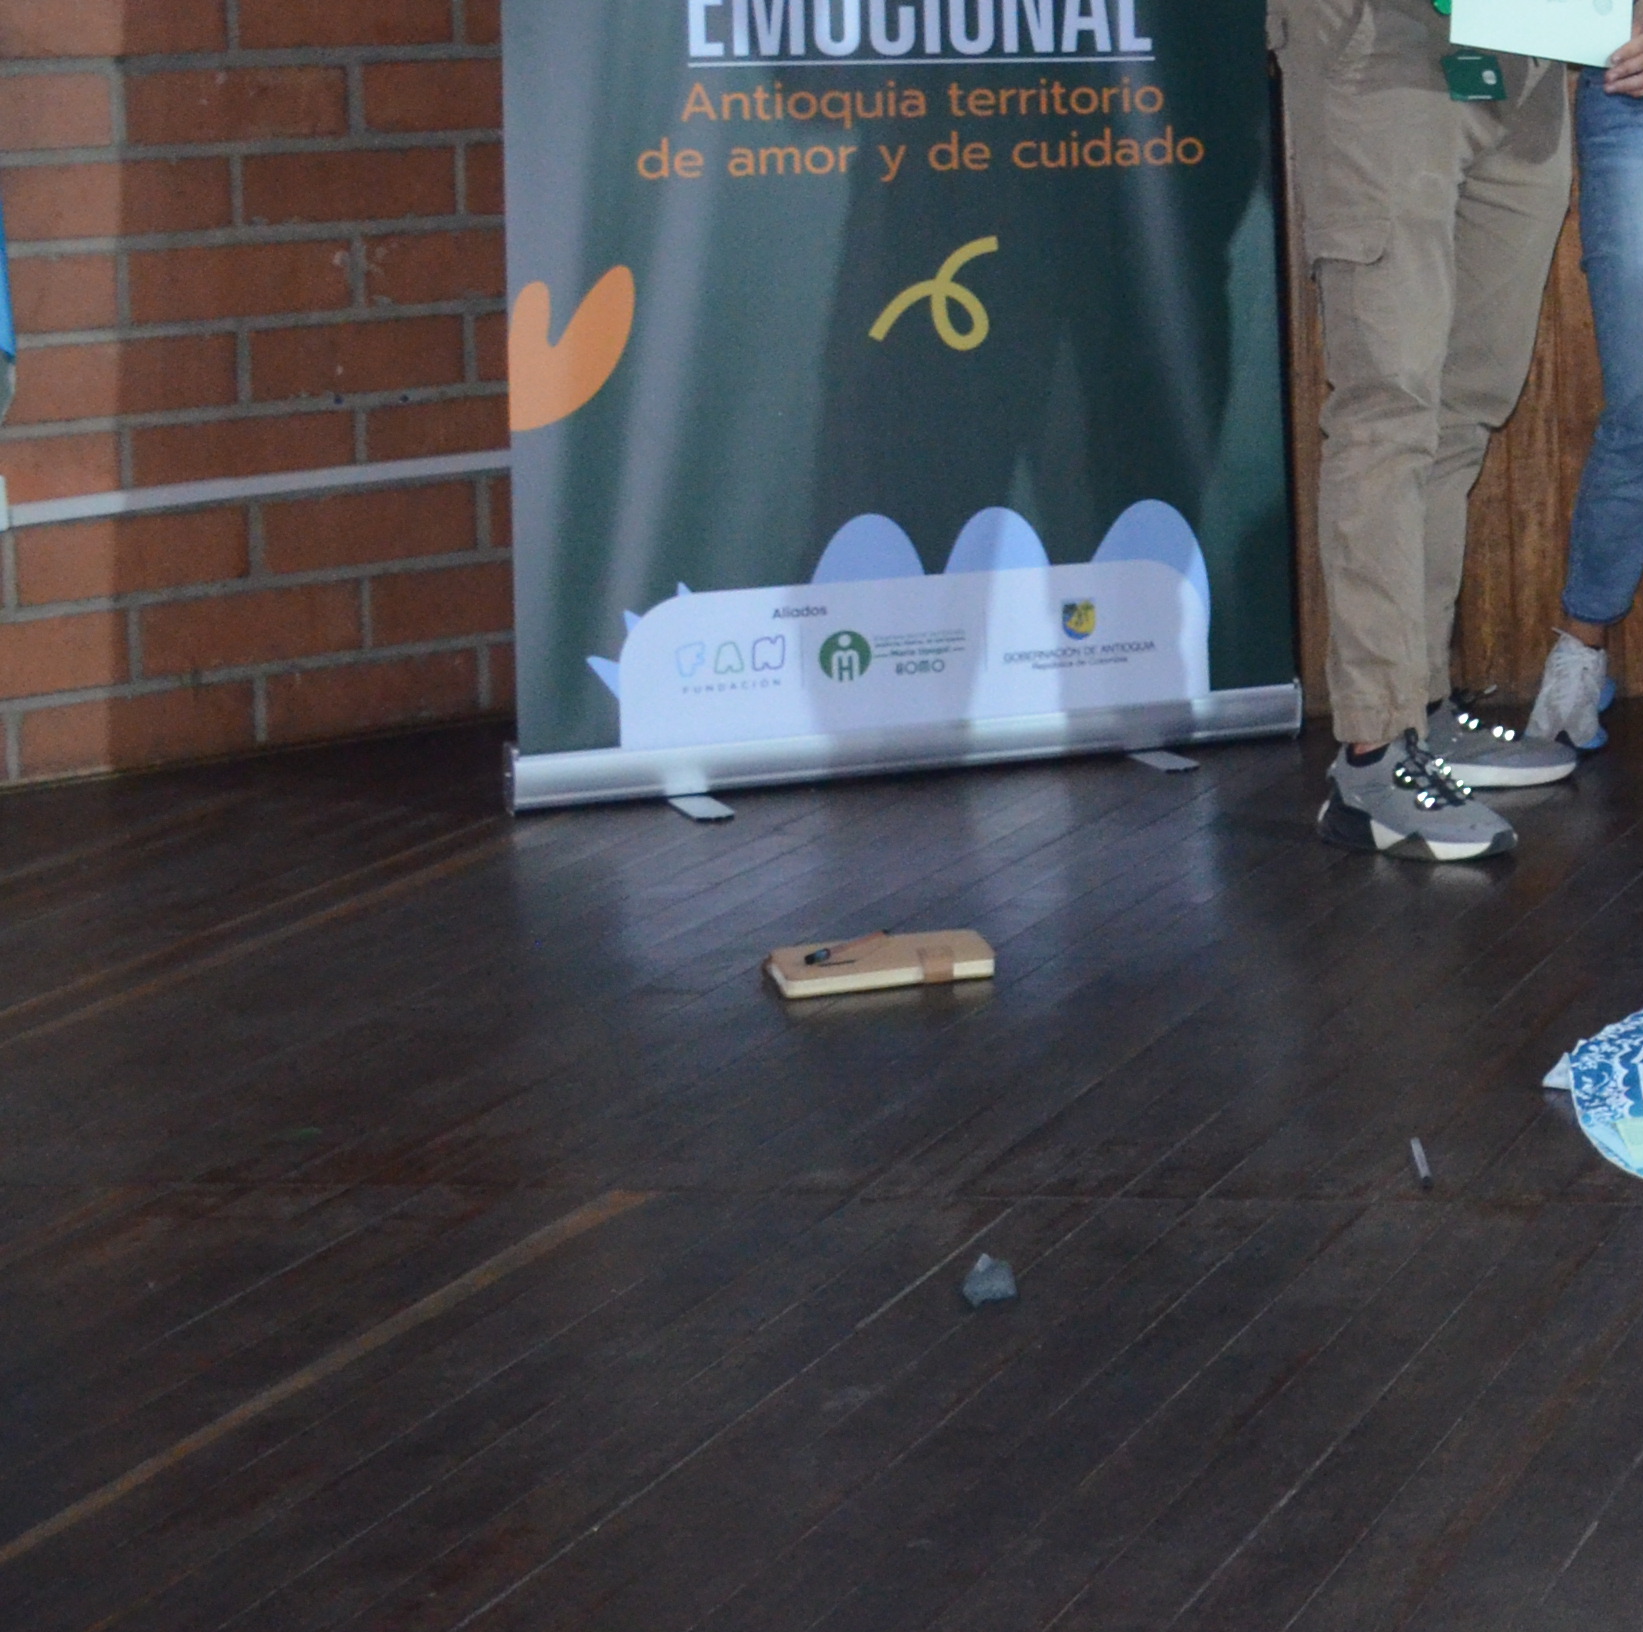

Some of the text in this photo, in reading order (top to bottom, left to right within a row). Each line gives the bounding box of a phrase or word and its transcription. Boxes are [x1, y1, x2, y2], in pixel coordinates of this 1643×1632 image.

[681, 77, 1165, 128] Antioquia territorio
[637, 126, 1206, 182] de amor y de cuidado
[772, 605, 828, 619] Aliados
